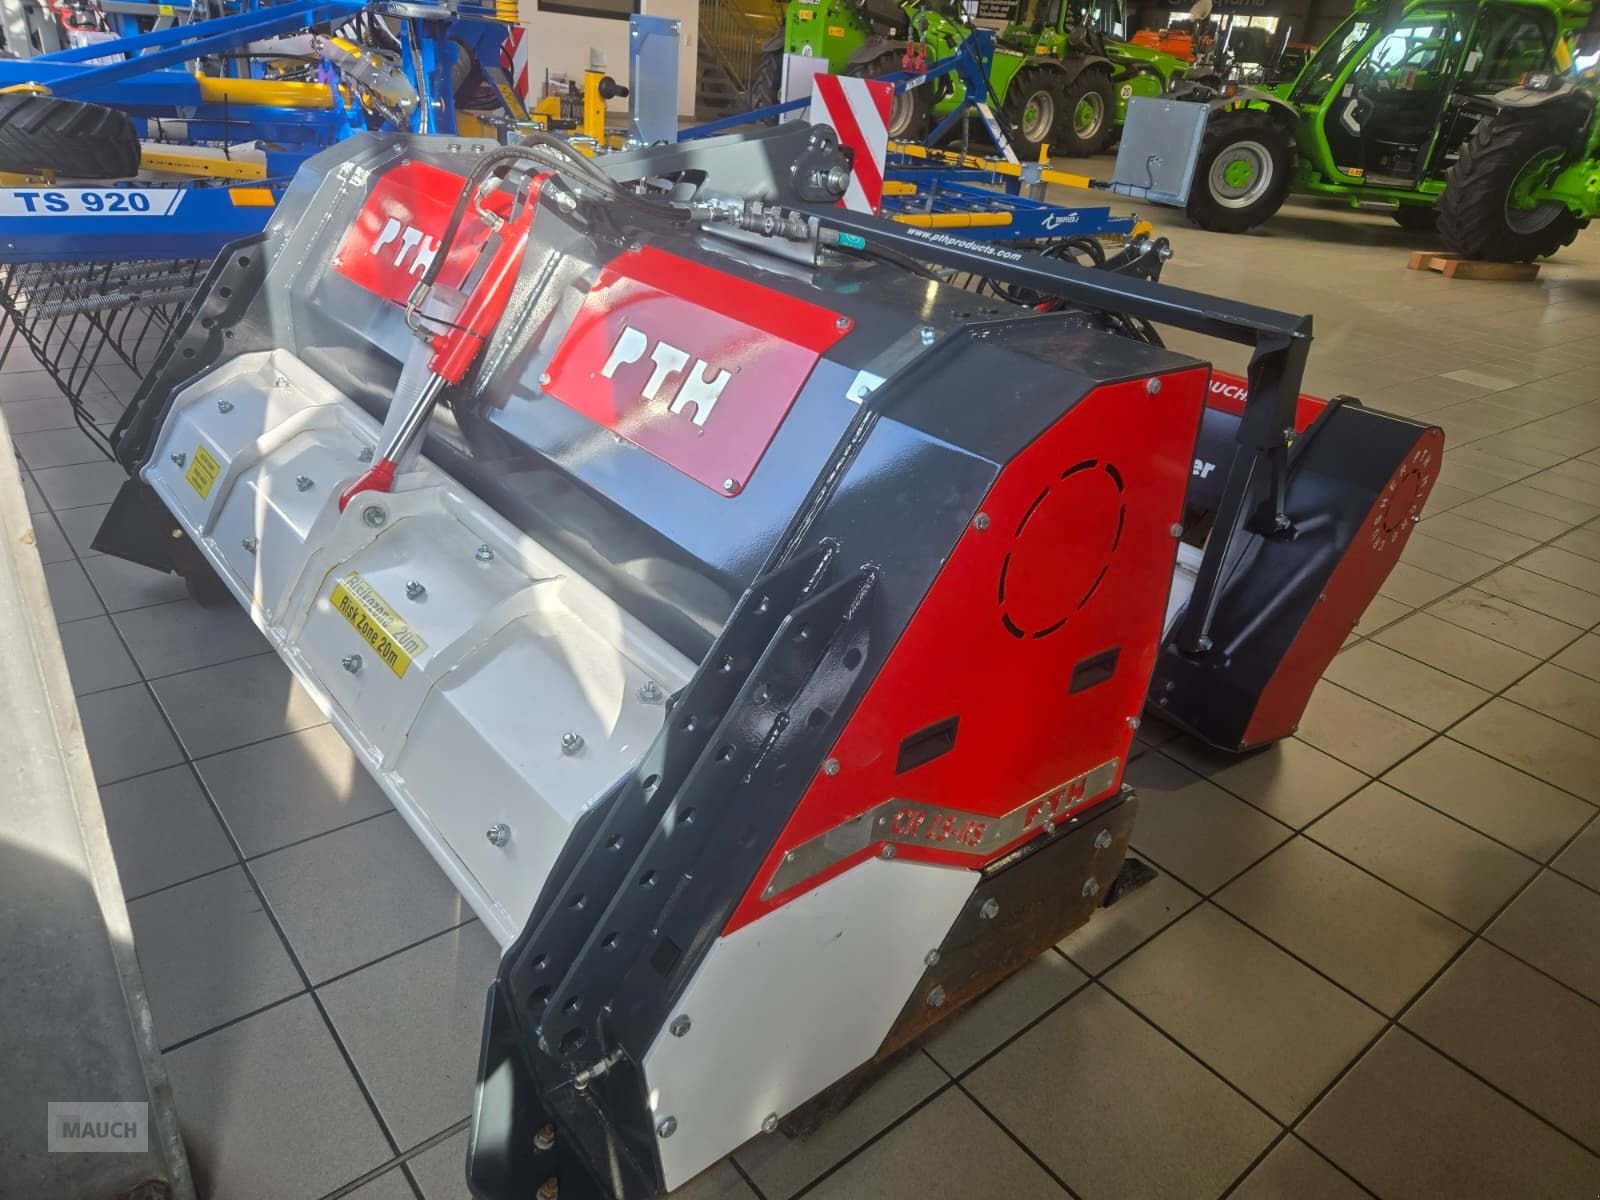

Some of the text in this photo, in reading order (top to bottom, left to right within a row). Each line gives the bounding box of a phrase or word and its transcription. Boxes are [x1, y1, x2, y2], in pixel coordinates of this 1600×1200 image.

[14, 192, 150, 212] TS 920
[370, 217, 441, 280] PTH
[907, 226, 1022, 262] www.pthproducts.com
[601, 326, 732, 427] PTH
[339, 595, 399, 666] Risk Zone 20m
[392, 626, 419, 653] 20m
[891, 807, 925, 837] CR
[1023, 777, 1088, 830] PTH
